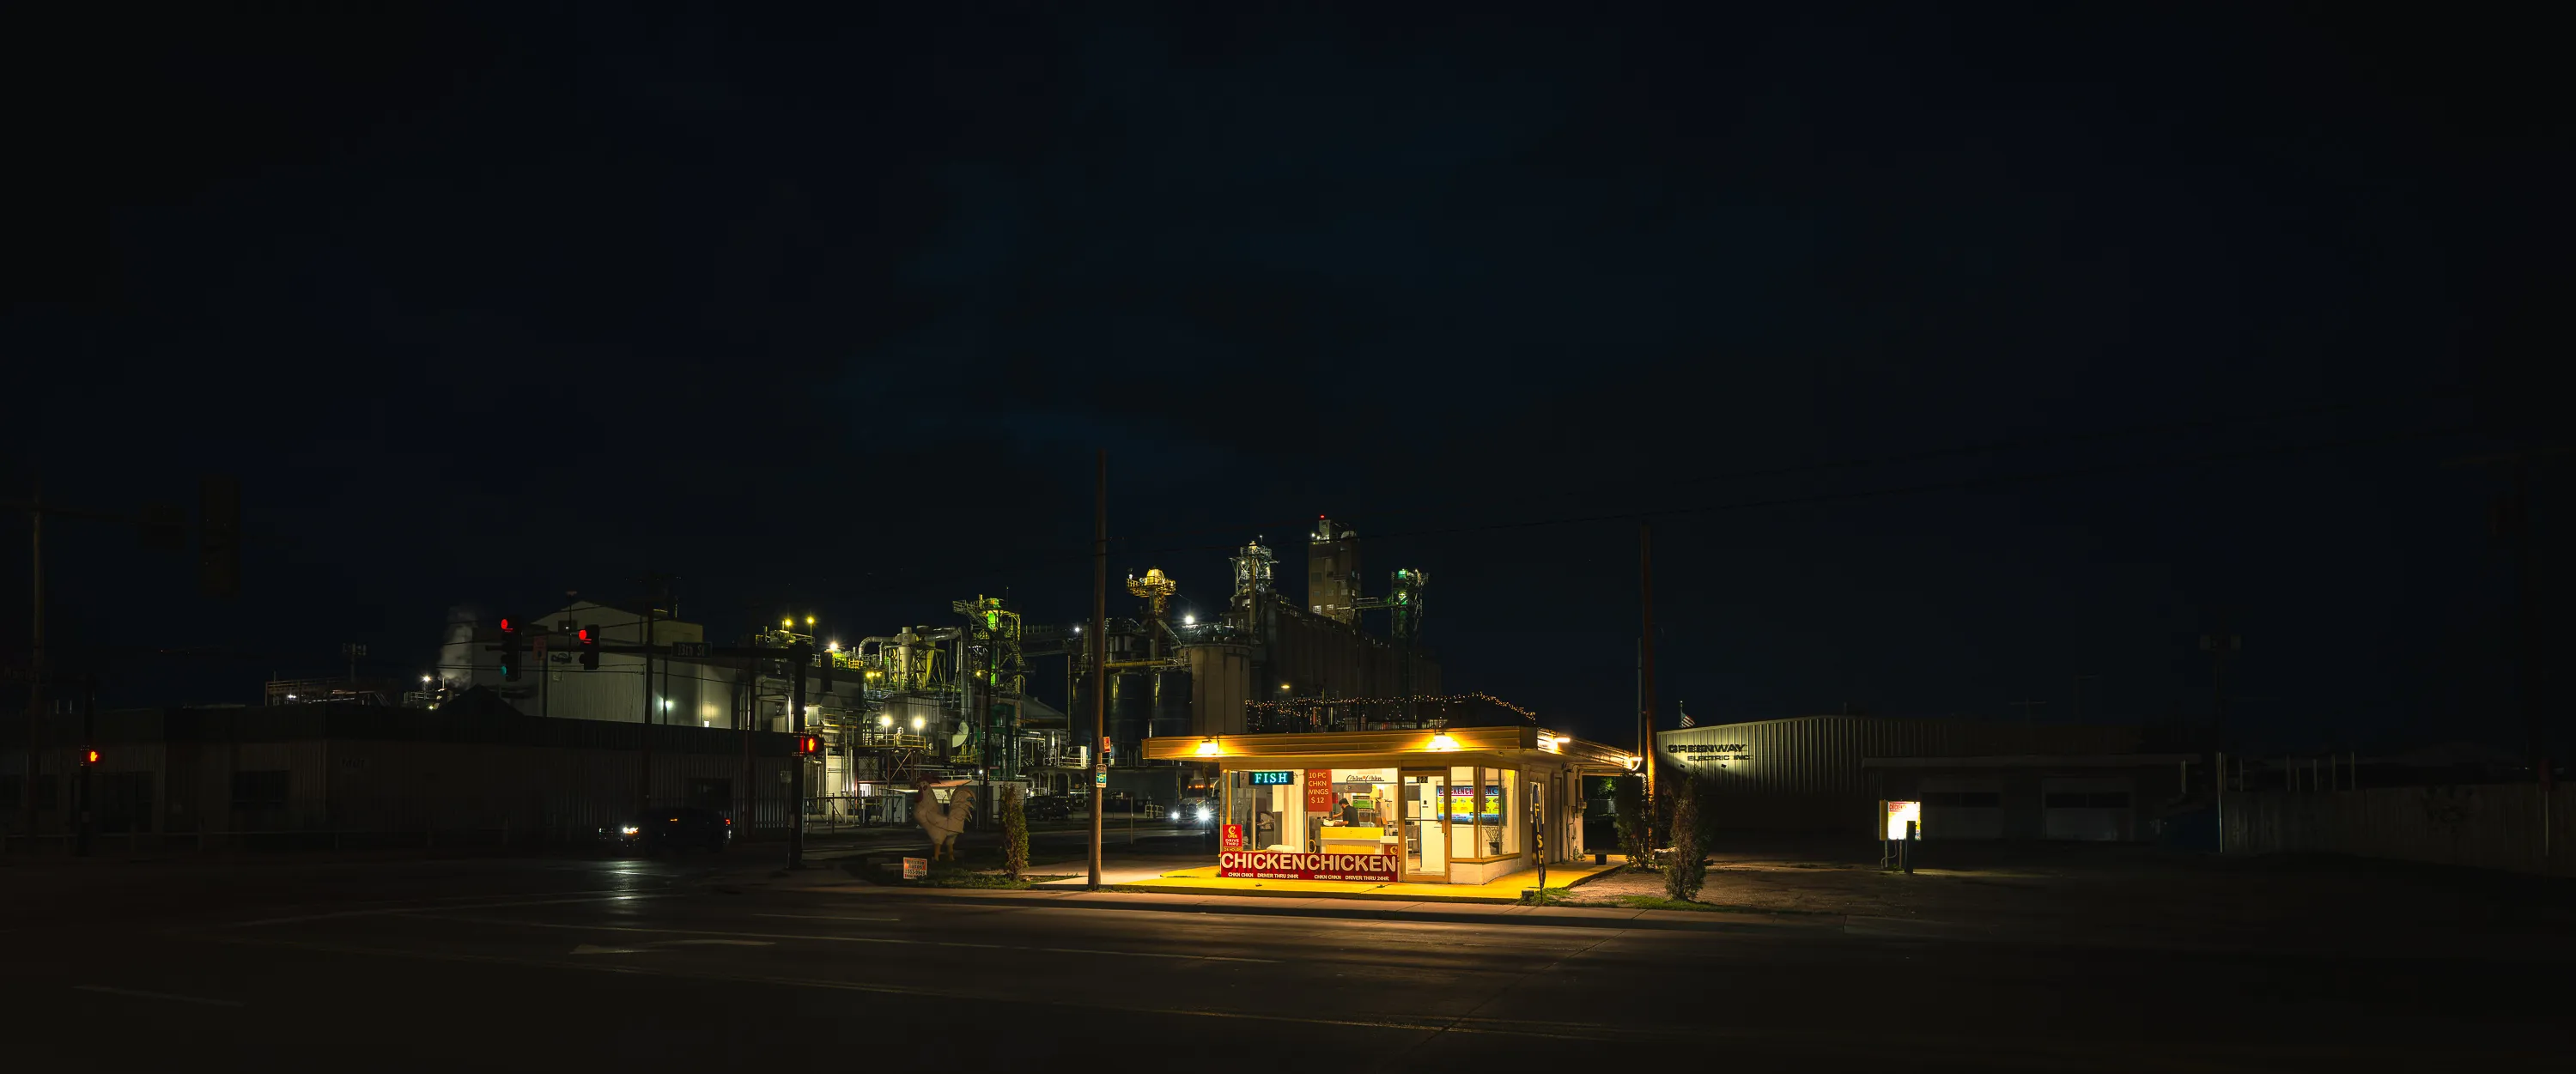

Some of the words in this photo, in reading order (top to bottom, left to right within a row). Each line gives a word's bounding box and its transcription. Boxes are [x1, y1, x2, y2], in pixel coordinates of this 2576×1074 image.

[1668, 744, 1747, 753] GREENWAY
[1255, 773, 1288, 784] FISH
[1310, 796, 1316, 804] $
[1534, 803, 1545, 865] FISH
